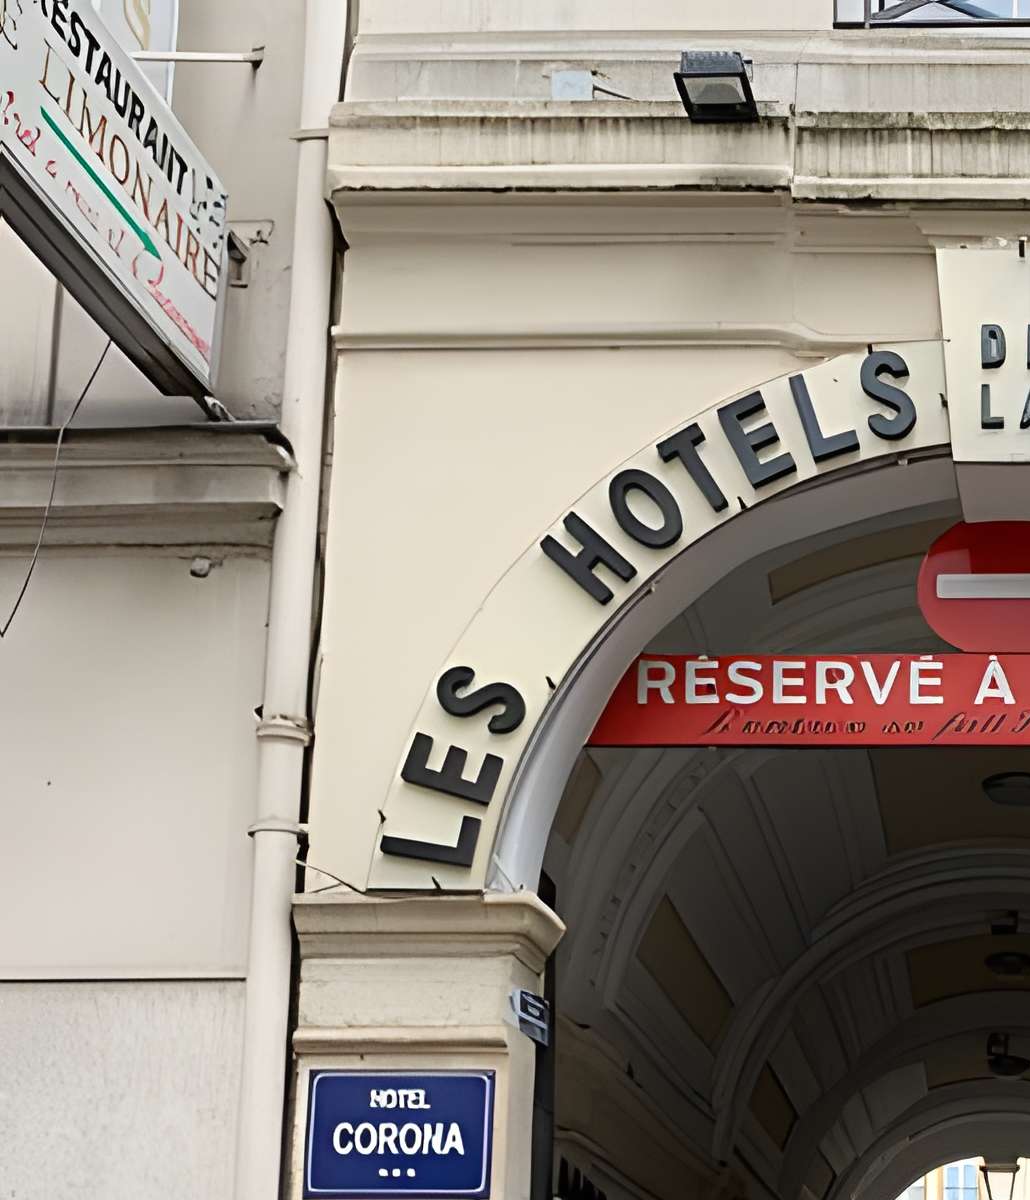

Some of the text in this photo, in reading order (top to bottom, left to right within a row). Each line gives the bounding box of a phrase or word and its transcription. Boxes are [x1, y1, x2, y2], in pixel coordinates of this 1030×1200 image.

[39, 38, 222, 301] LIMONAIRE
[379, 351, 917, 869] LES HOTELS
[637, 654, 944, 706] RÉSERVÉ
[332, 1121, 465, 1156] CORONA
